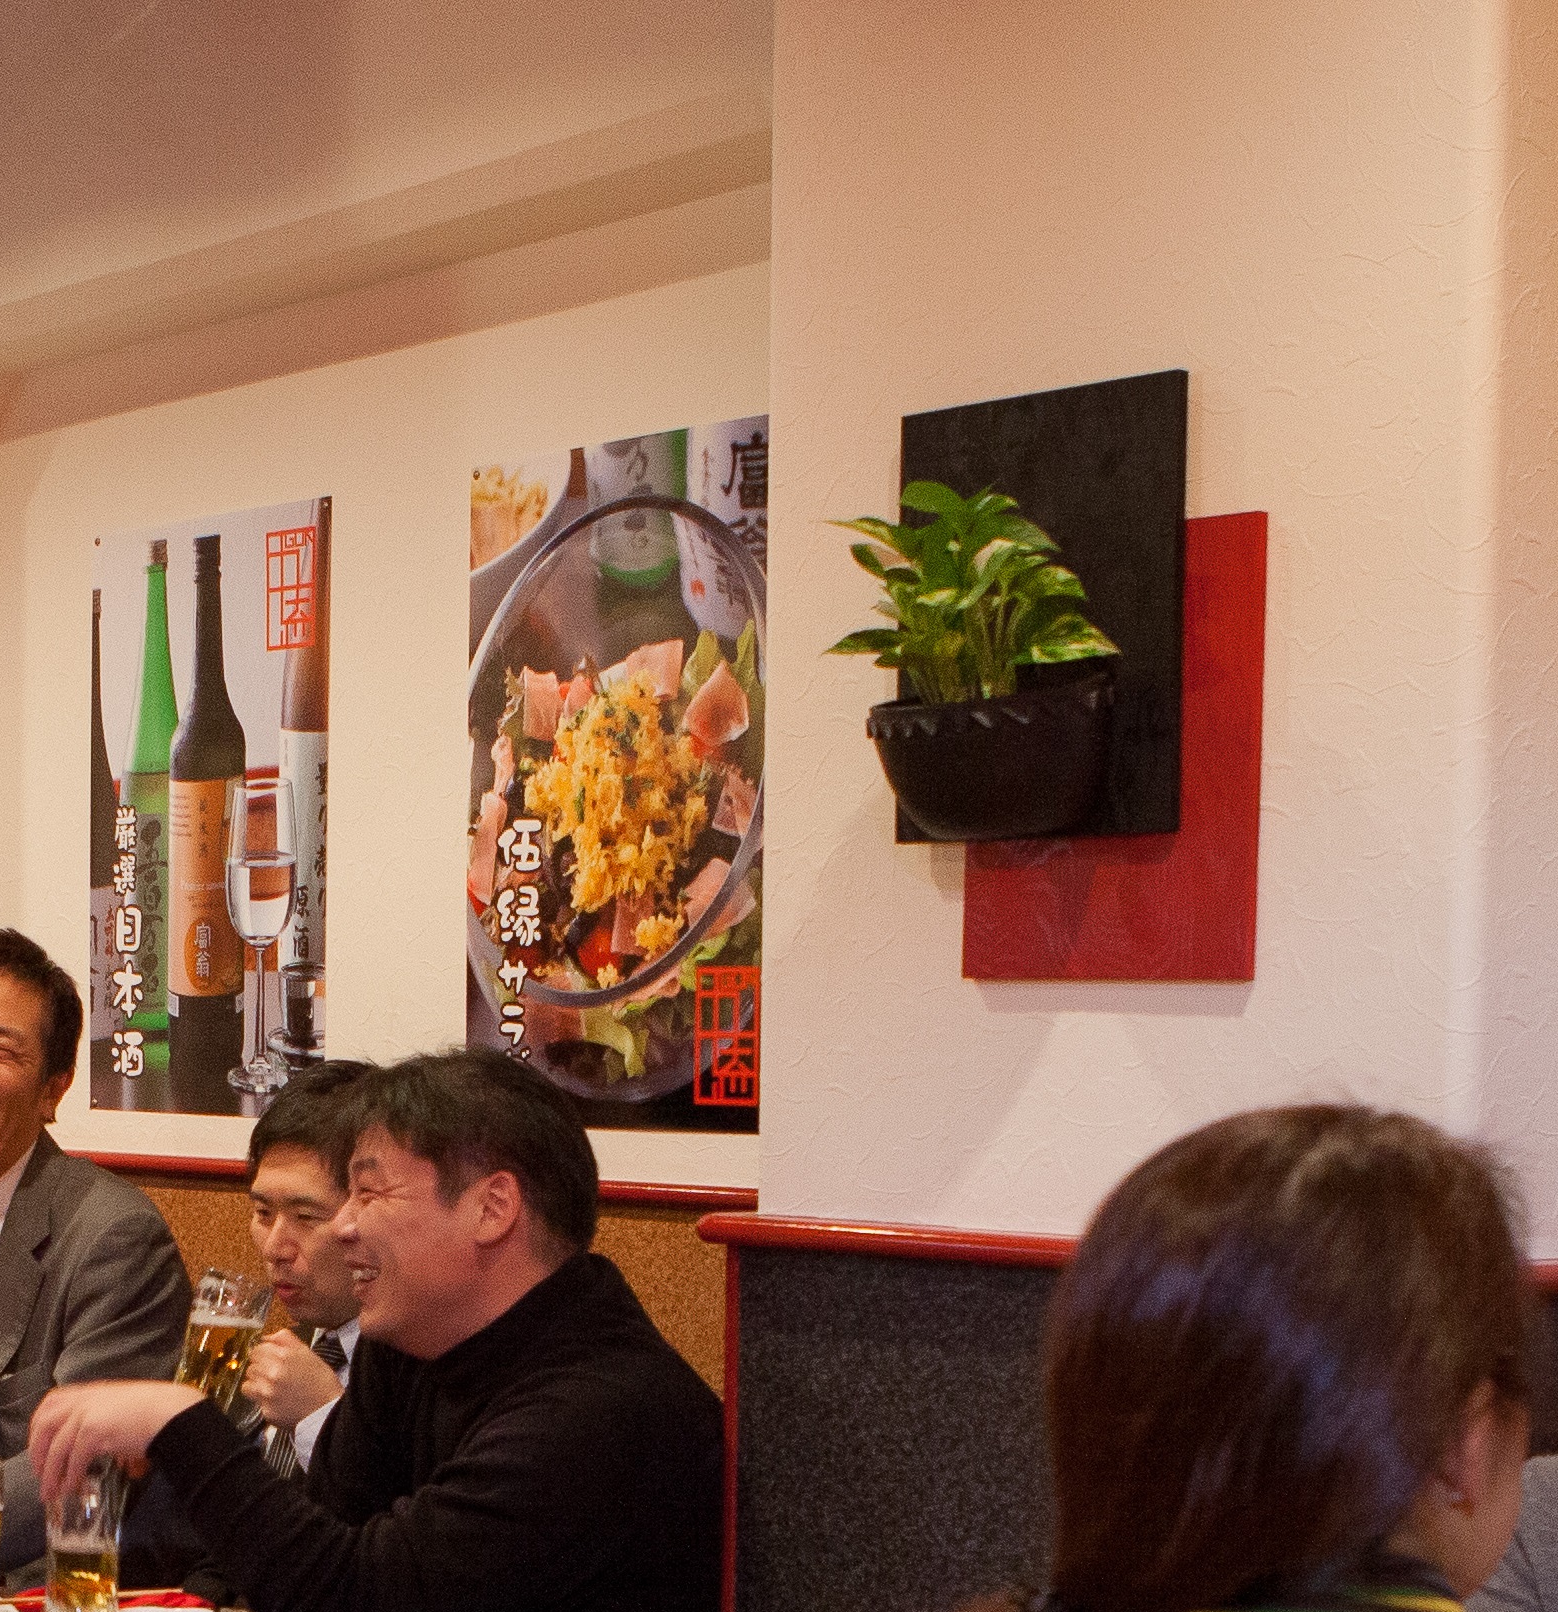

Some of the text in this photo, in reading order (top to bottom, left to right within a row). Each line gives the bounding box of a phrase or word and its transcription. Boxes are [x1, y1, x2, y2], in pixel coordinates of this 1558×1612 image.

[111, 804, 145, 1078] 厳選日本酒
[496, 818, 543, 1060] 伍縁サラ
